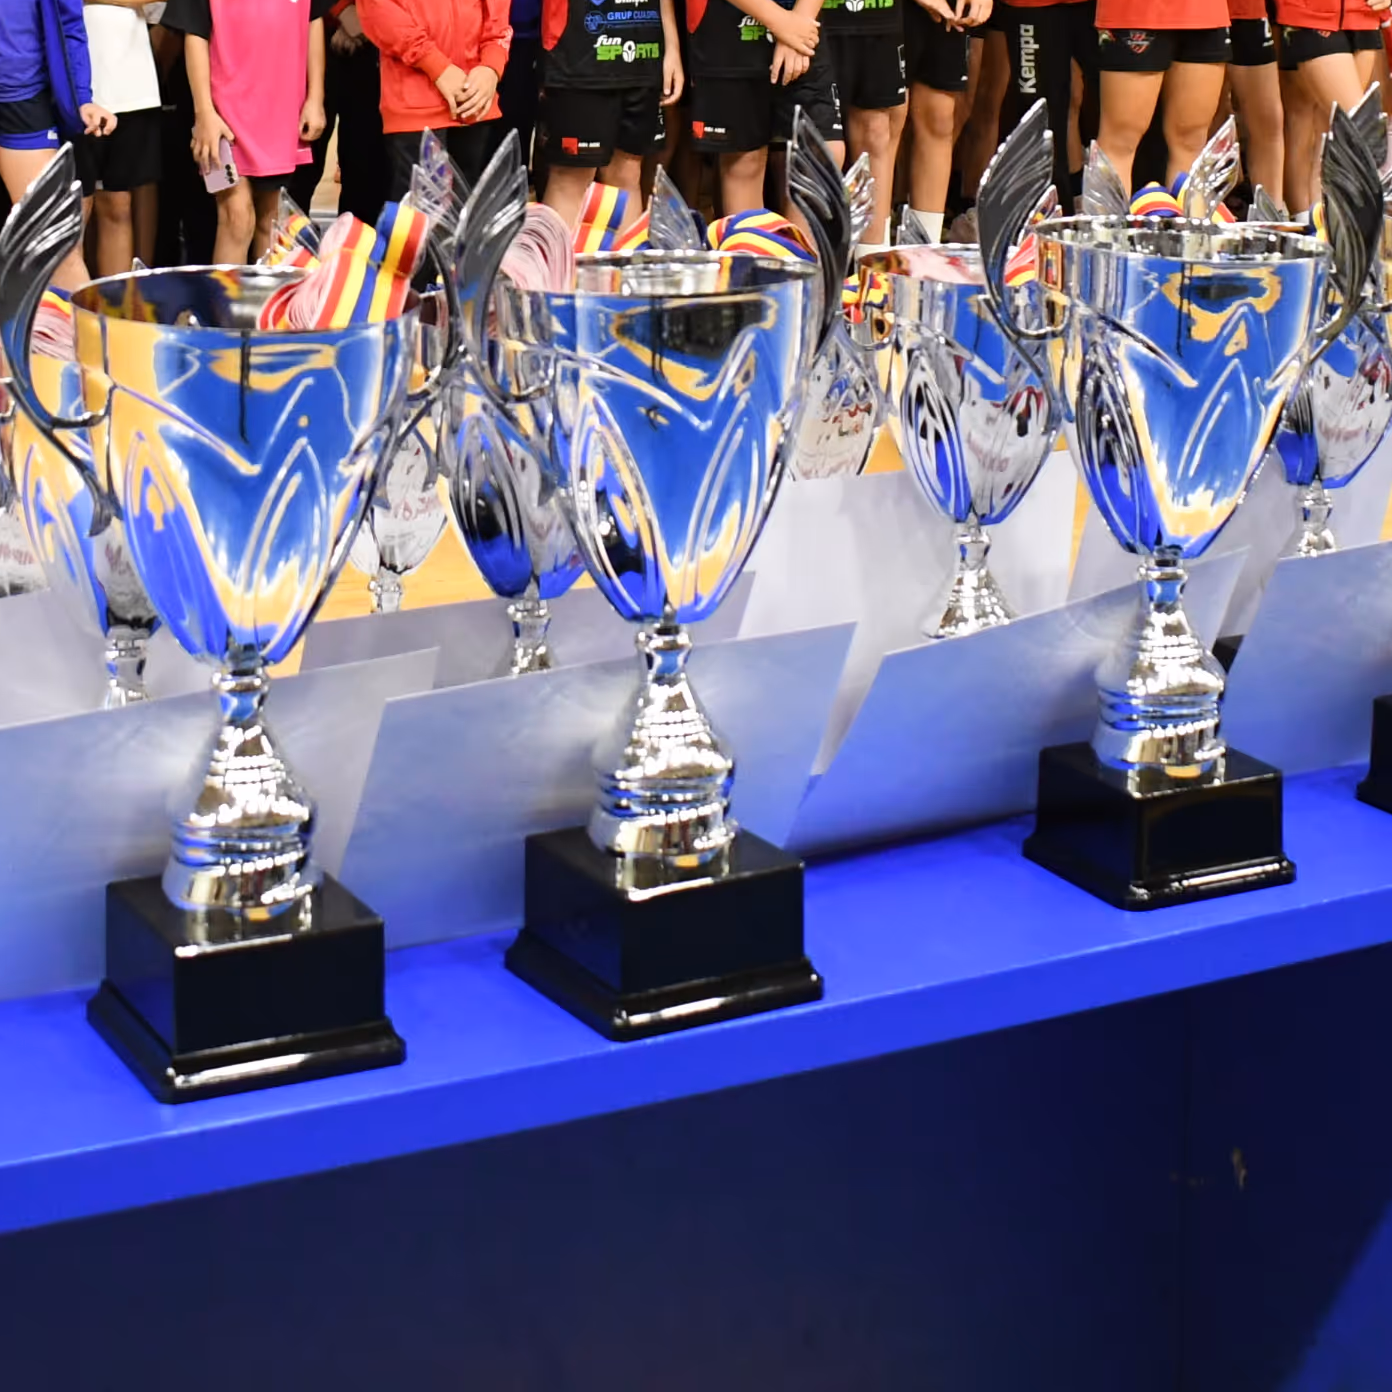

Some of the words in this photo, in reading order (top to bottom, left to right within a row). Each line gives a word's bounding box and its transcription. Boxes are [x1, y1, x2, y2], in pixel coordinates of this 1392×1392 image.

[607, 12, 632, 20] GRUP
[594, 35, 622, 48] fun
[1020, 24, 1039, 94] Kempa
